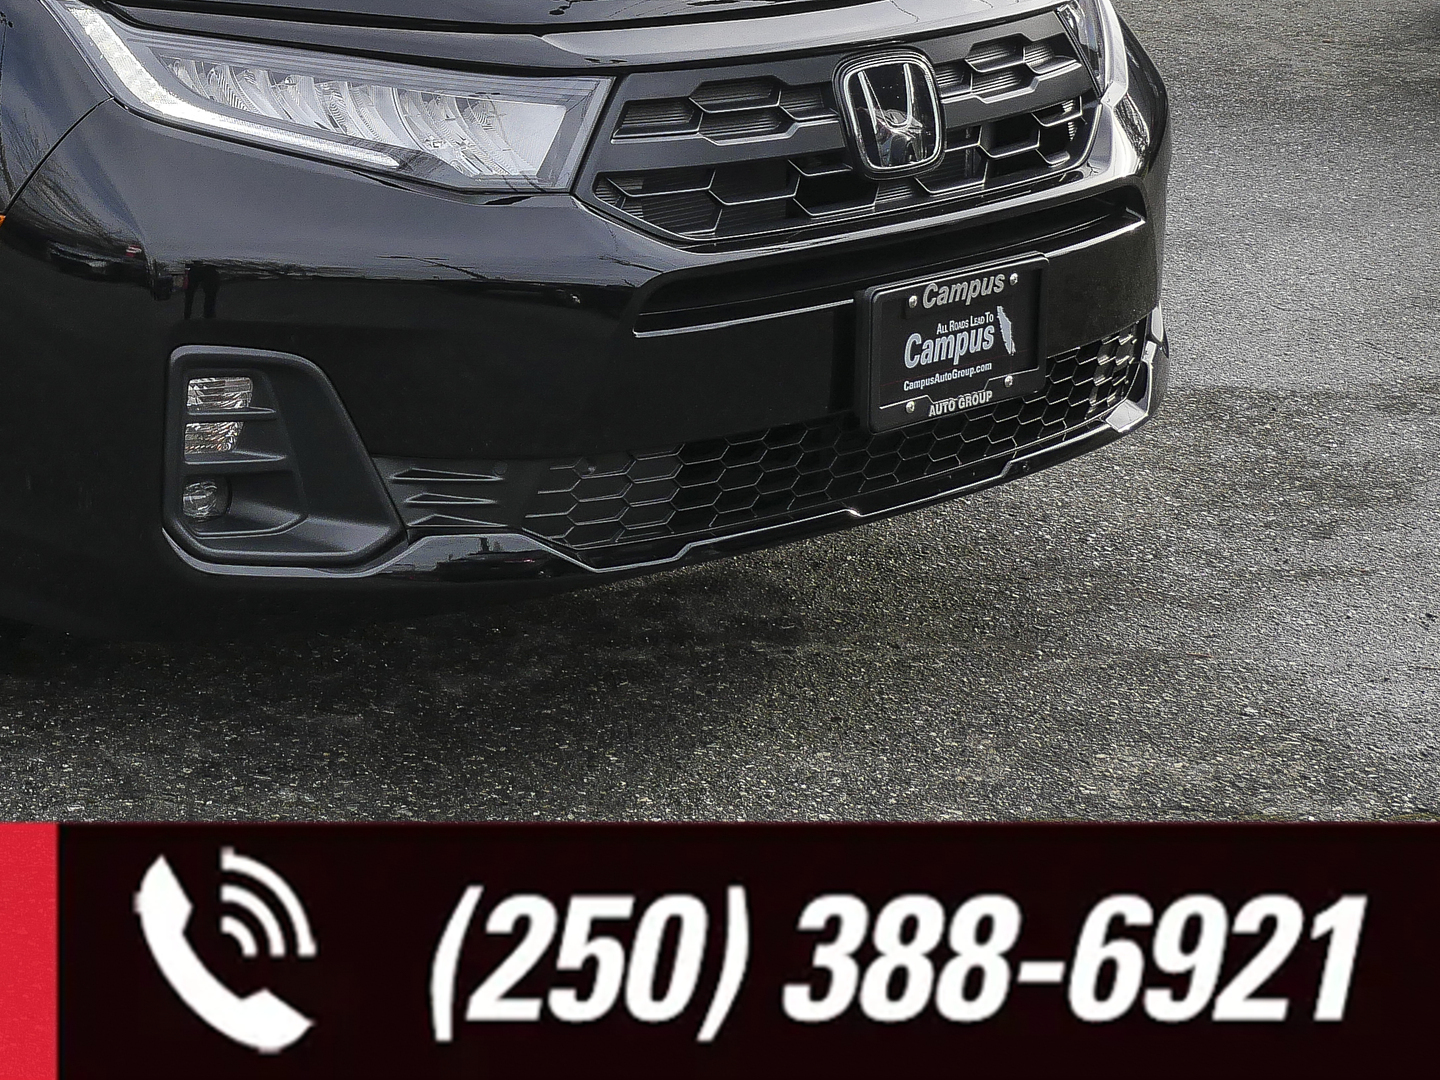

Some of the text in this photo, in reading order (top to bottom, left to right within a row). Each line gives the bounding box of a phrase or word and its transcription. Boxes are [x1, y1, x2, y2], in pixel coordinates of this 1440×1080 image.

[923, 274, 1005, 308] Campus
[904, 325, 995, 369] Campus
[903, 362, 992, 391] CampusAutoGroup.com
[928, 390, 993, 417] AUTO GROUP
